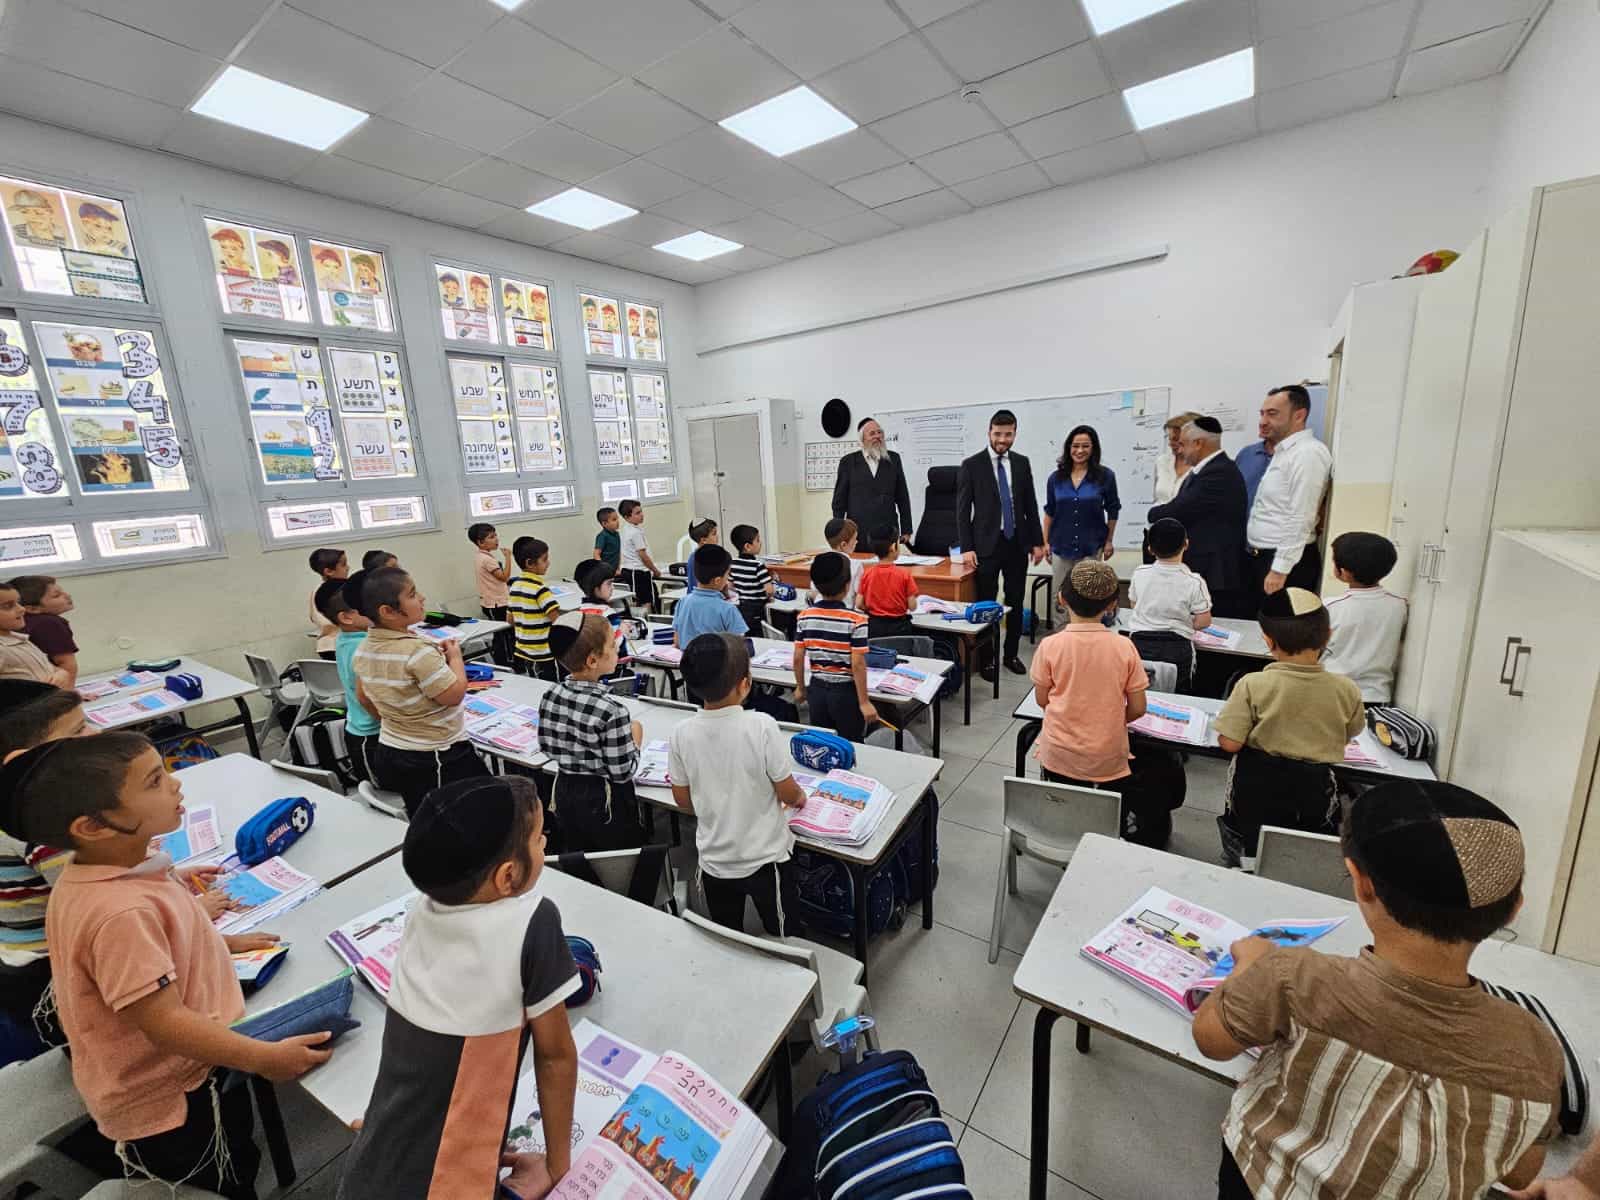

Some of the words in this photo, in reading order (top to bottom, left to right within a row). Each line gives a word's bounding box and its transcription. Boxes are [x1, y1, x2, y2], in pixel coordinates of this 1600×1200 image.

[115, 332, 160, 378] 3
[301, 348, 312, 359] ש
[384, 355, 392, 364] פ
[491, 365, 498, 374] מ
[306, 380, 318, 390] ת
[343, 378, 375, 390] תשע
[388, 386, 397, 396] צ
[461, 385, 484, 396] שבע
[519, 389, 541, 399] חמש
[127, 381, 170, 424] 4
[0, 390, 44, 436] 7
[305, 406, 335, 445] 1
[393, 419, 402, 430] ק
[139, 425, 182, 468] 5
[355, 443, 385, 455] עשר
[464, 442, 496, 453] שמונה
[502, 447, 509, 456] ע
[529, 442, 544, 451] שש
[311, 443, 343, 480] 2
[16, 441, 63, 494] 8
